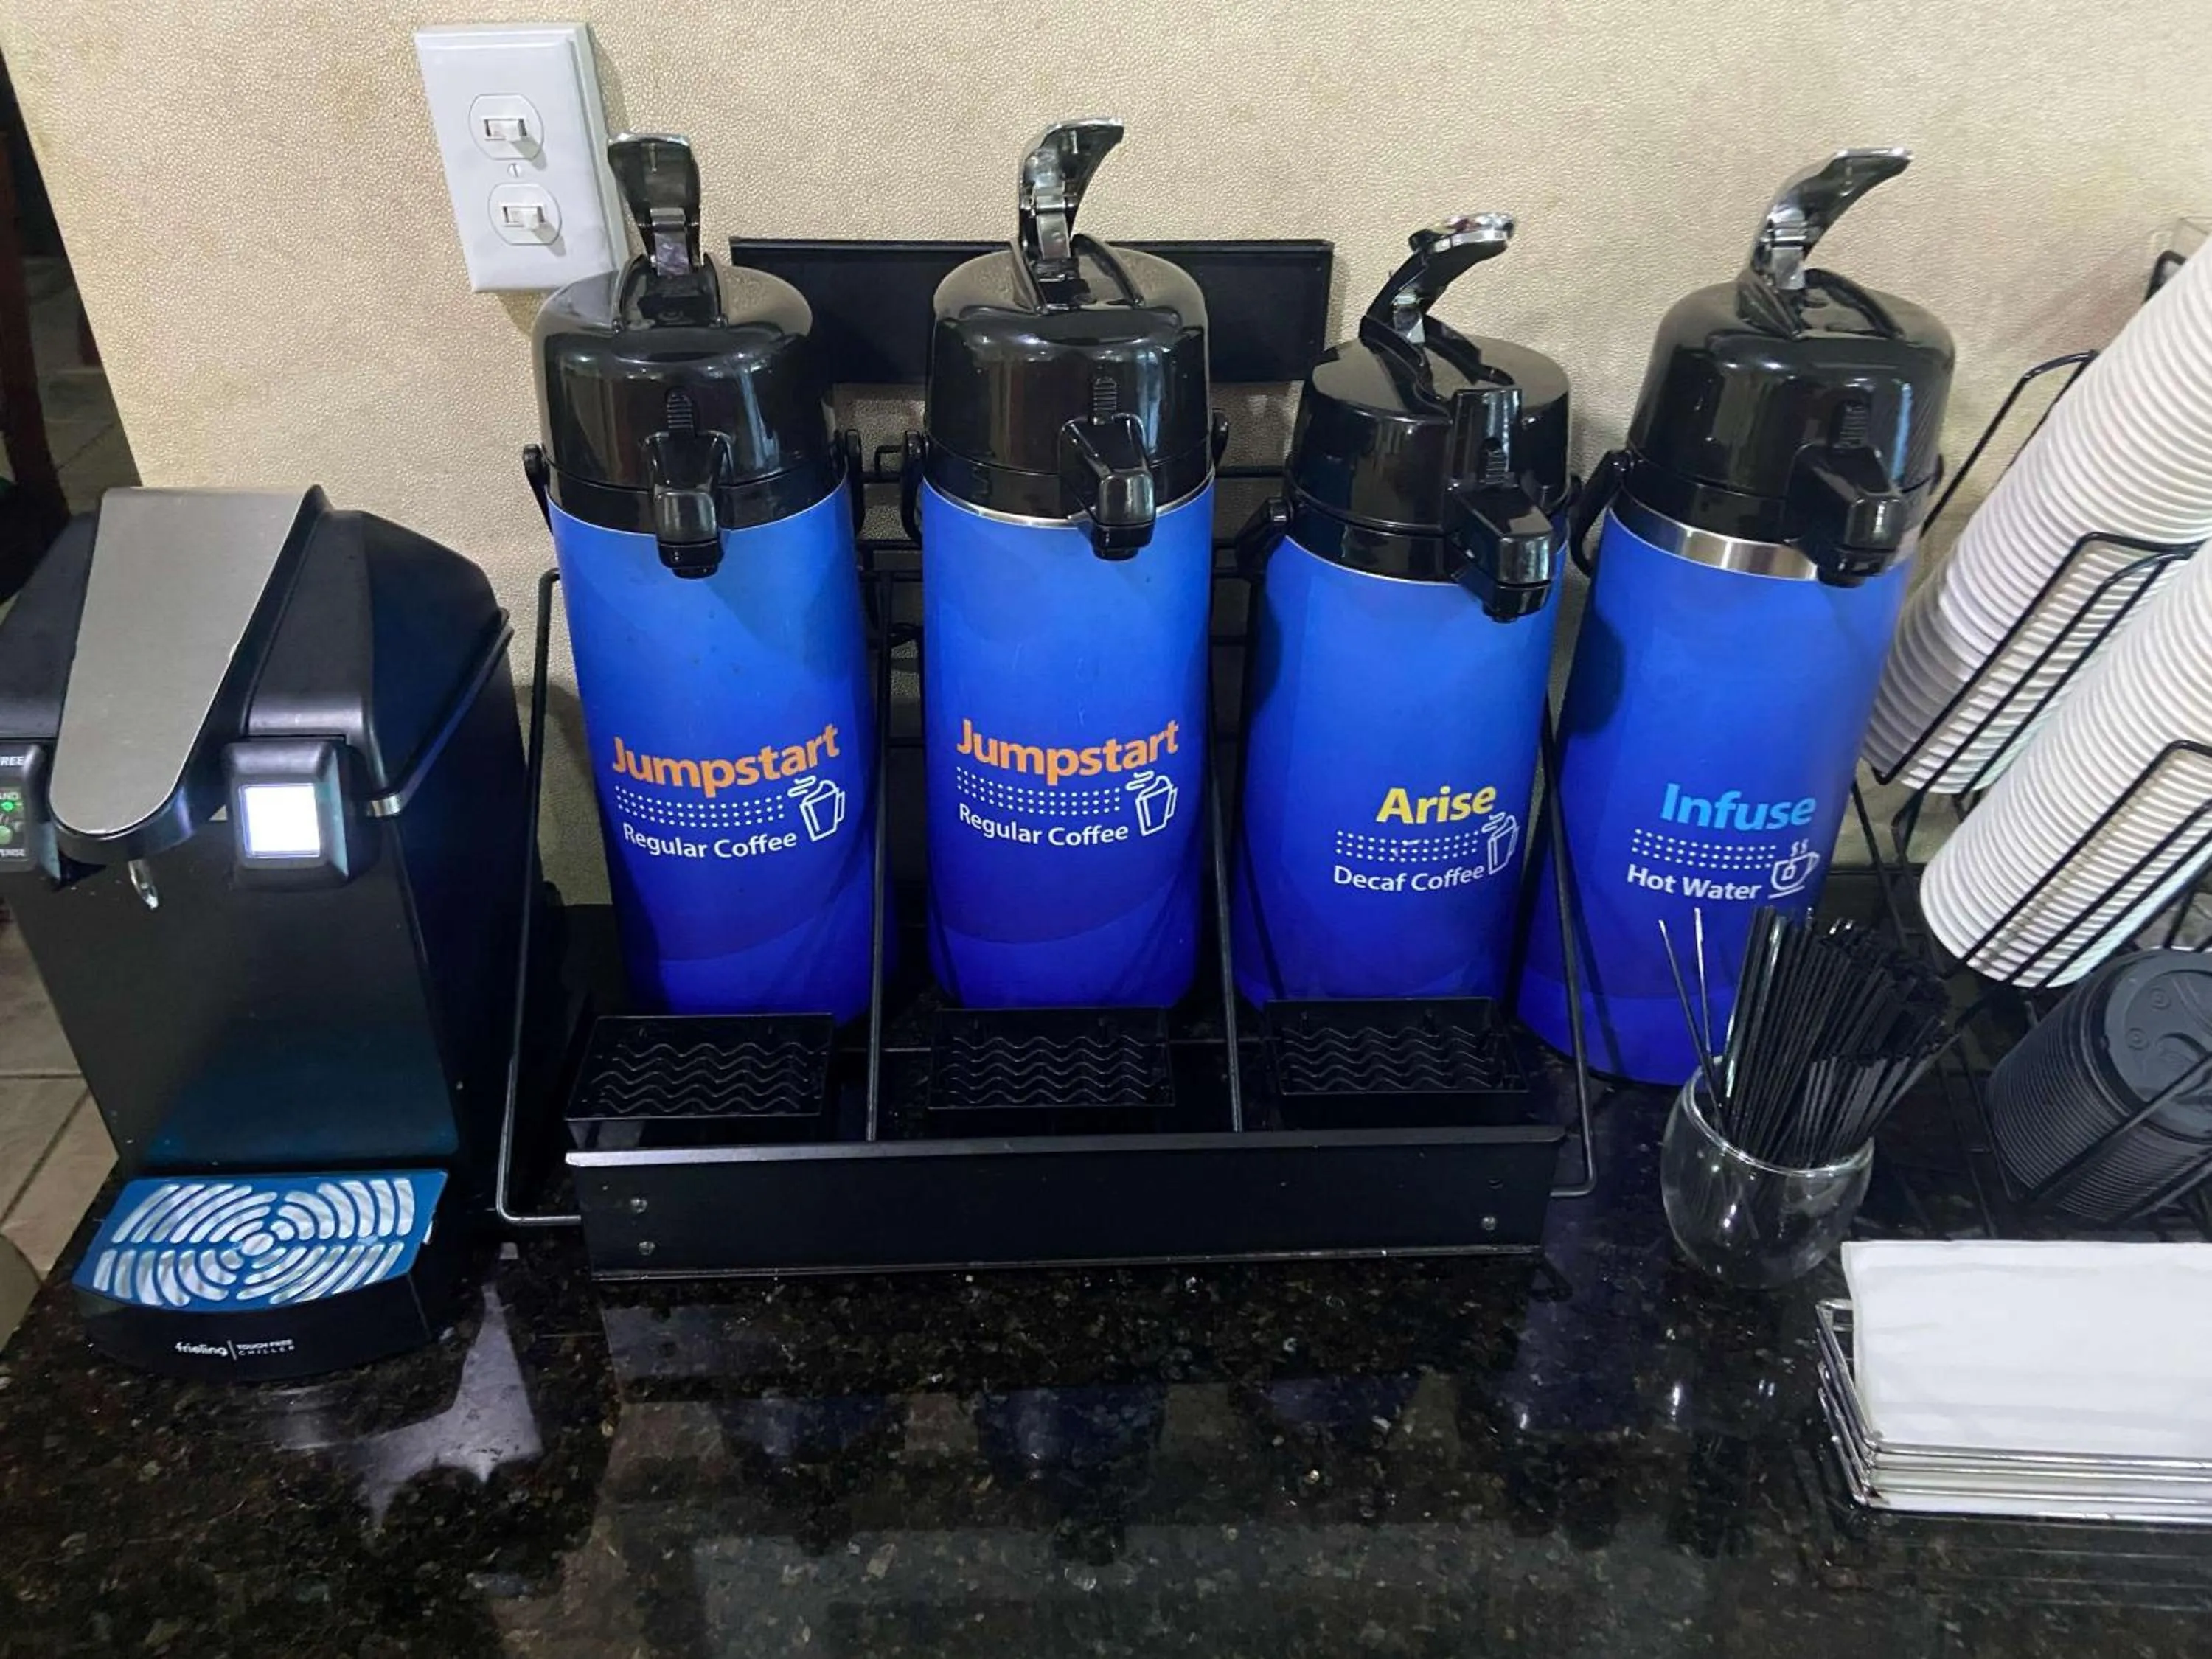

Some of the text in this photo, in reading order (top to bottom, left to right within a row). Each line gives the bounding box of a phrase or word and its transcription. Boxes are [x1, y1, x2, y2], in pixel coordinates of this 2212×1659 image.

[0, 755, 24, 767] REE
[613, 723, 840, 799] Jumpstart
[957, 718, 1179, 787] Jumpstart
[959, 802, 1130, 846] Regular Coffee
[1376, 785, 1497, 824] Arise
[1660, 782, 1817, 831] Infuse
[622, 822, 797, 858] Regular Coffee
[1333, 864, 1486, 892] Decaf Coffee
[1627, 863, 1762, 900] Hot Water
